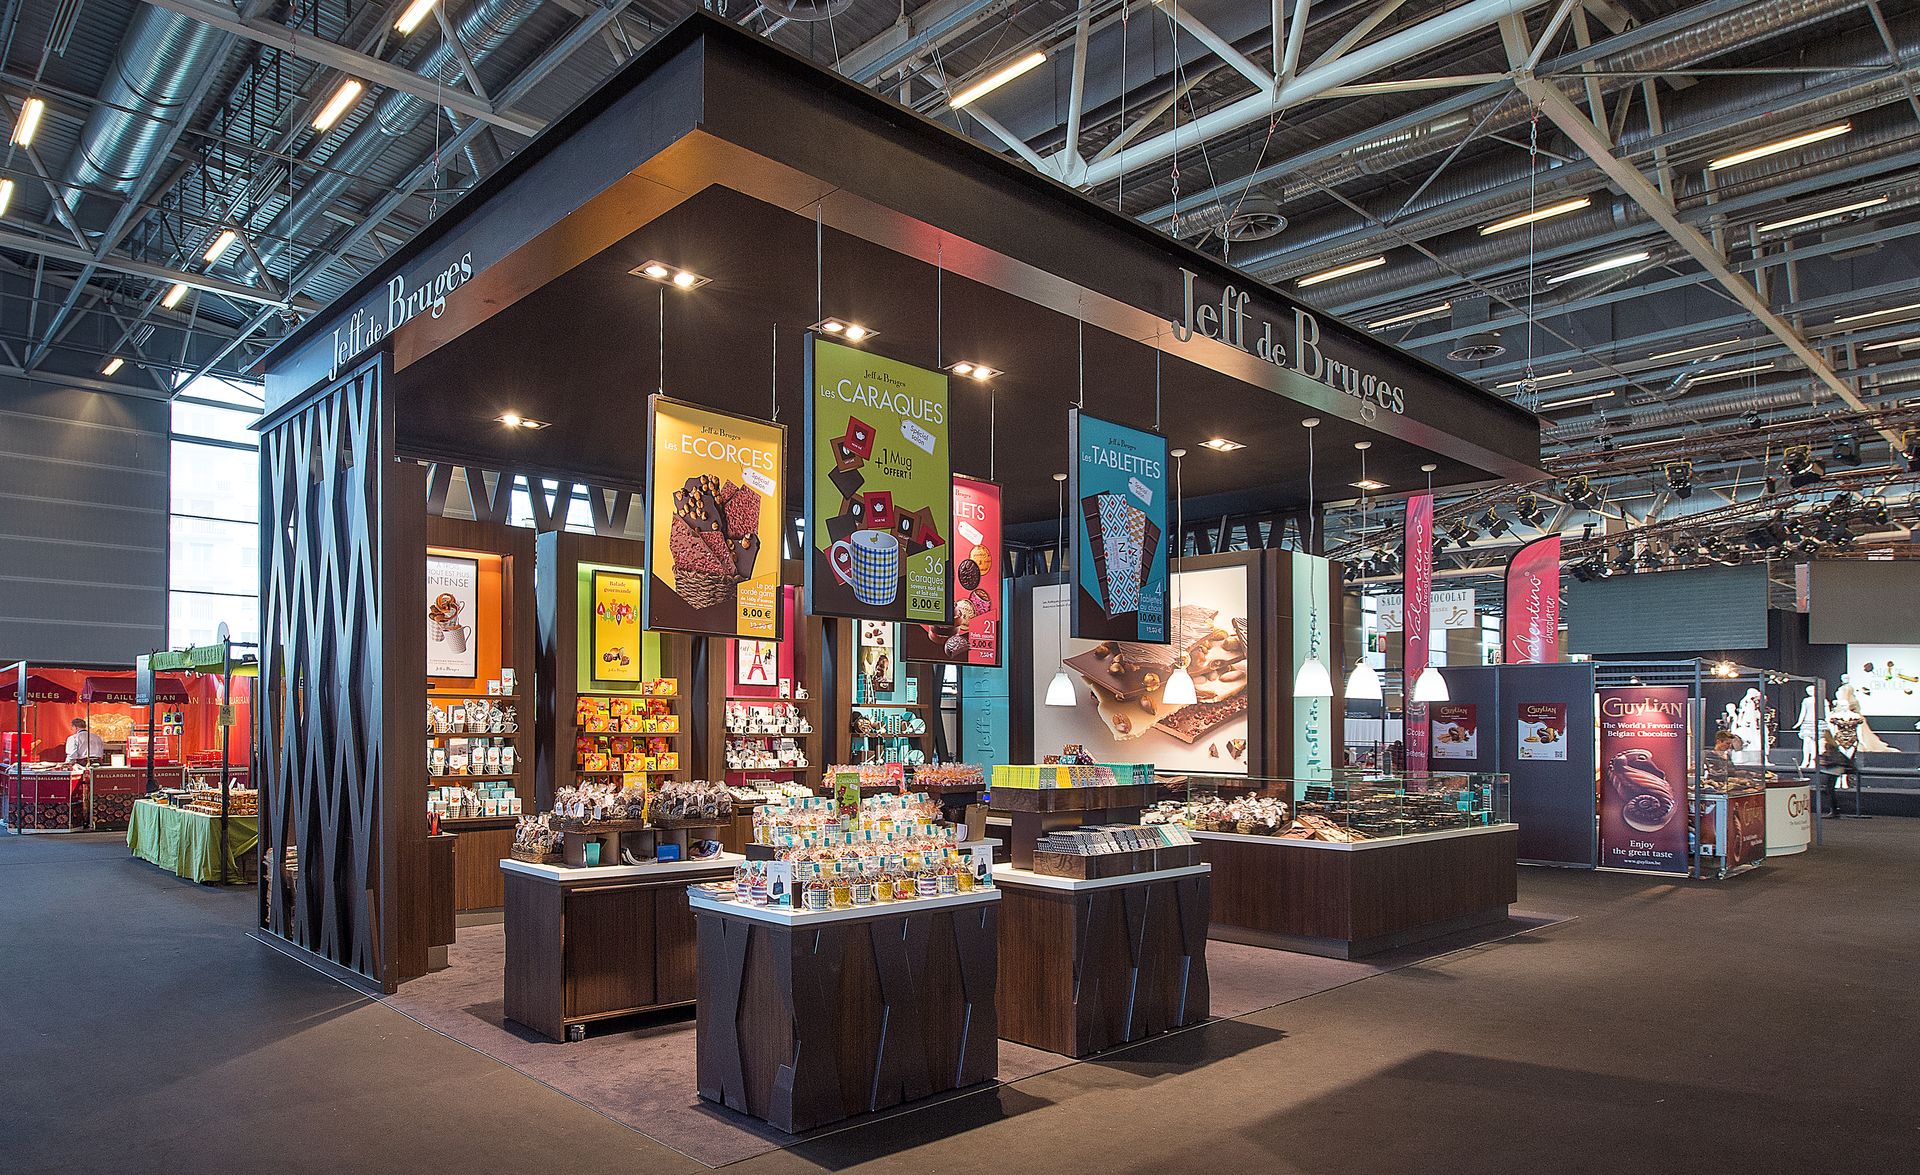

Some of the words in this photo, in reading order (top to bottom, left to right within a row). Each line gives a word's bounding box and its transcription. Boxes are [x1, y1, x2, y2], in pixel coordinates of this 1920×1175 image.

[328, 308, 364, 381] Jeff
[366, 315, 382, 348] de
[383, 251, 472, 337] Bruges
[1171, 267, 1252, 352] Jeff
[1256, 321, 1287, 367] de
[1290, 306, 1405, 422] Bruges
[883, 373, 906, 388] Bruges
[820, 385, 836, 399] Les
[837, 379, 943, 425] CARAQUES
[664, 439, 678, 452] Les
[681, 434, 774, 471] ECORCES
[890, 450, 912, 471] Mug
[1082, 452, 1092, 463] Les
[1092, 445, 1160, 479] TABLETTES
[883, 467, 908, 480] OFFERT
[955, 500, 985, 521] LETS
[925, 555, 943, 575] 36
[428, 576, 468, 587] INTENSE
[909, 570, 944, 586] Caraques
[1155, 582, 1162, 597] 4
[1381, 596, 1402, 606] SALO
[1431, 591, 1467, 603] OCOLAT
[912, 598, 932, 610] 8,00
[934, 600, 940, 610] €
[743, 608, 762, 618] 8,00
[765, 610, 771, 619] €
[1543, 596, 1557, 643] chocolatier
[984, 620, 995, 634] 21
[972, 640, 986, 648] 5,00
[14, 691, 60, 699] CNELÉS
[106, 693, 176, 701] BAILLRAN
[1617, 722, 1646, 730] World's
[1647, 722, 1684, 730] Favourite
[1607, 730, 1636, 739] Belgian
[1637, 730, 1678, 738] Chocolates
[1630, 840, 1655, 850] Enjoy
[1612, 848, 1627, 856] the
[1628, 849, 1650, 858] great
[1652, 850, 1673, 859] taste
